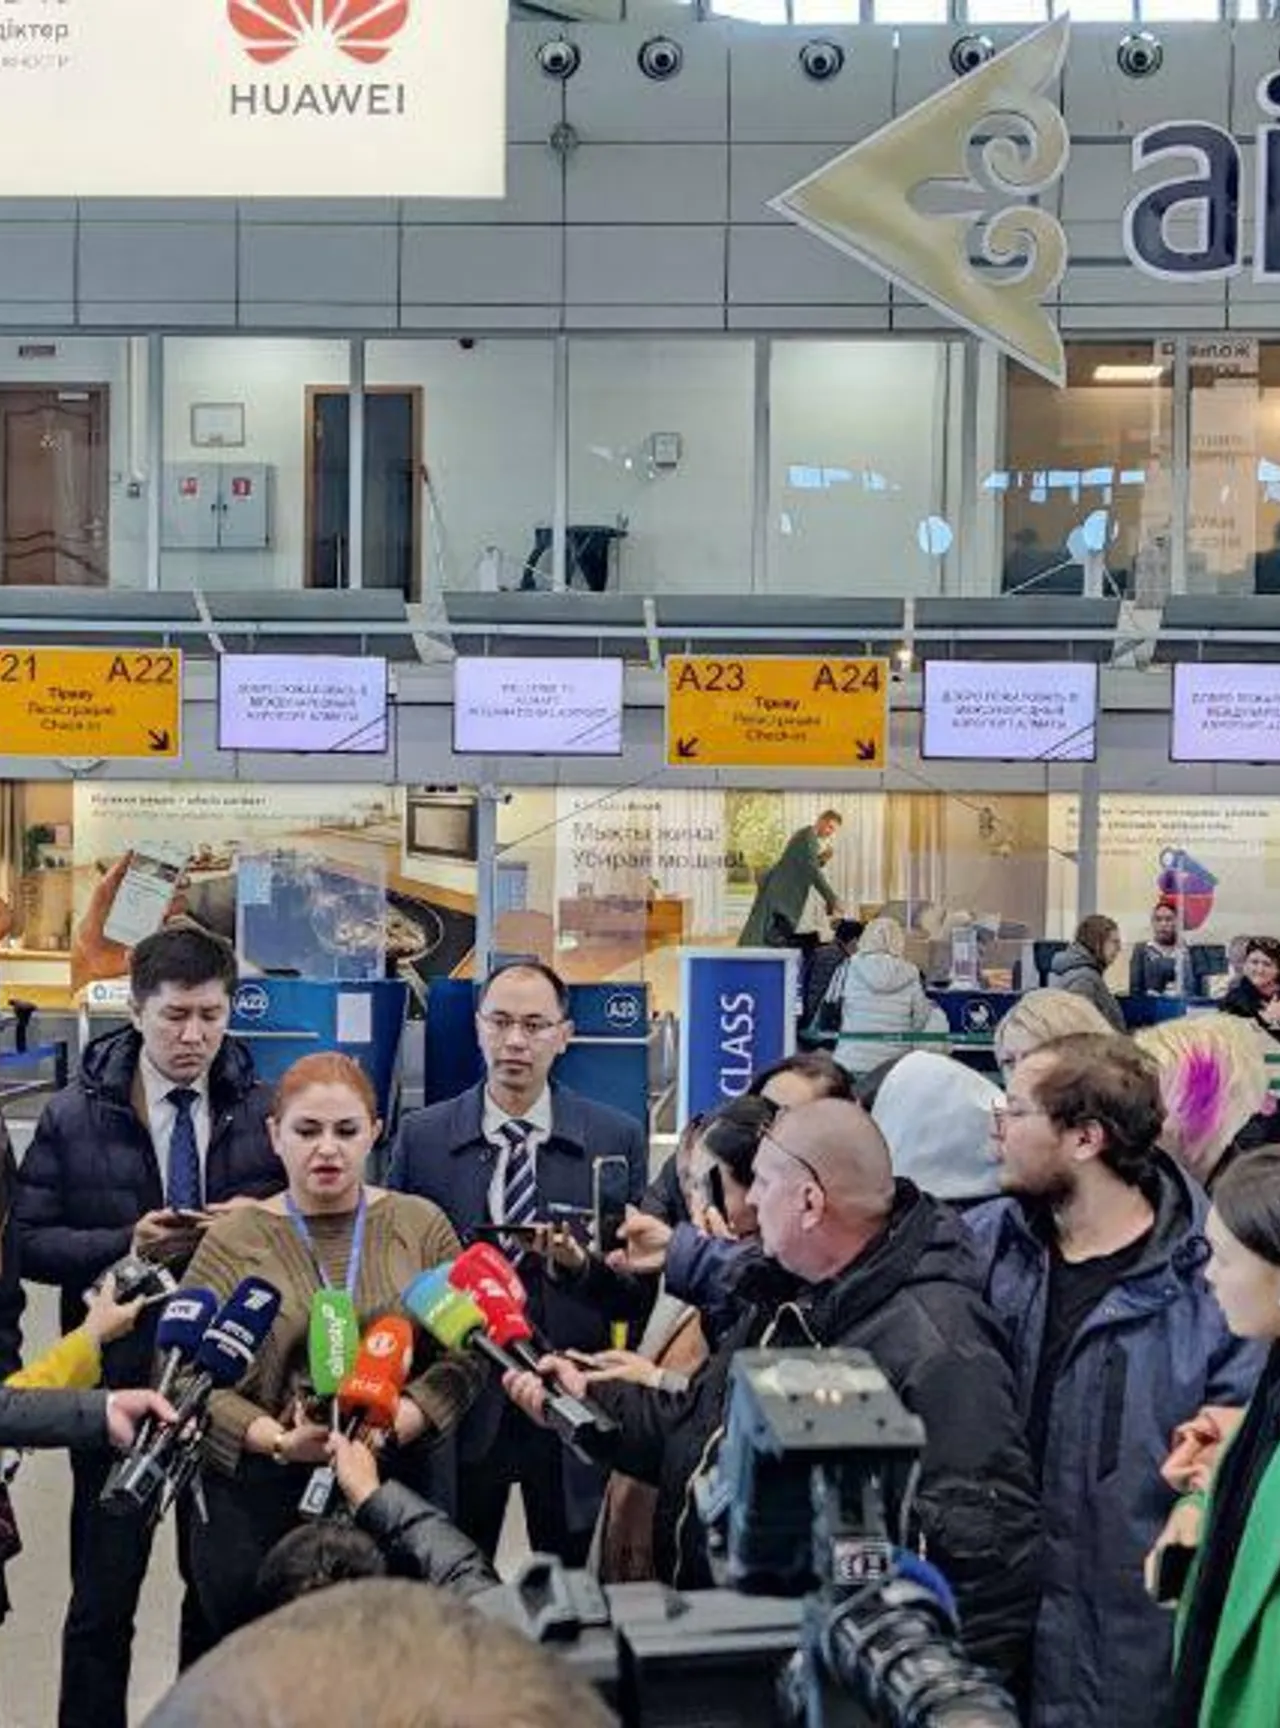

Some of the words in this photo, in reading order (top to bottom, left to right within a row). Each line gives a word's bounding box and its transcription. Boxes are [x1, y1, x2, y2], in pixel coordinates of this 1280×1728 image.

[230, 84, 406, 116] HUAWEI
[107, 656, 174, 685] A22
[676, 663, 745, 692] A23
[813, 665, 881, 694] A24
[720, 992, 756, 1097] CLASS
